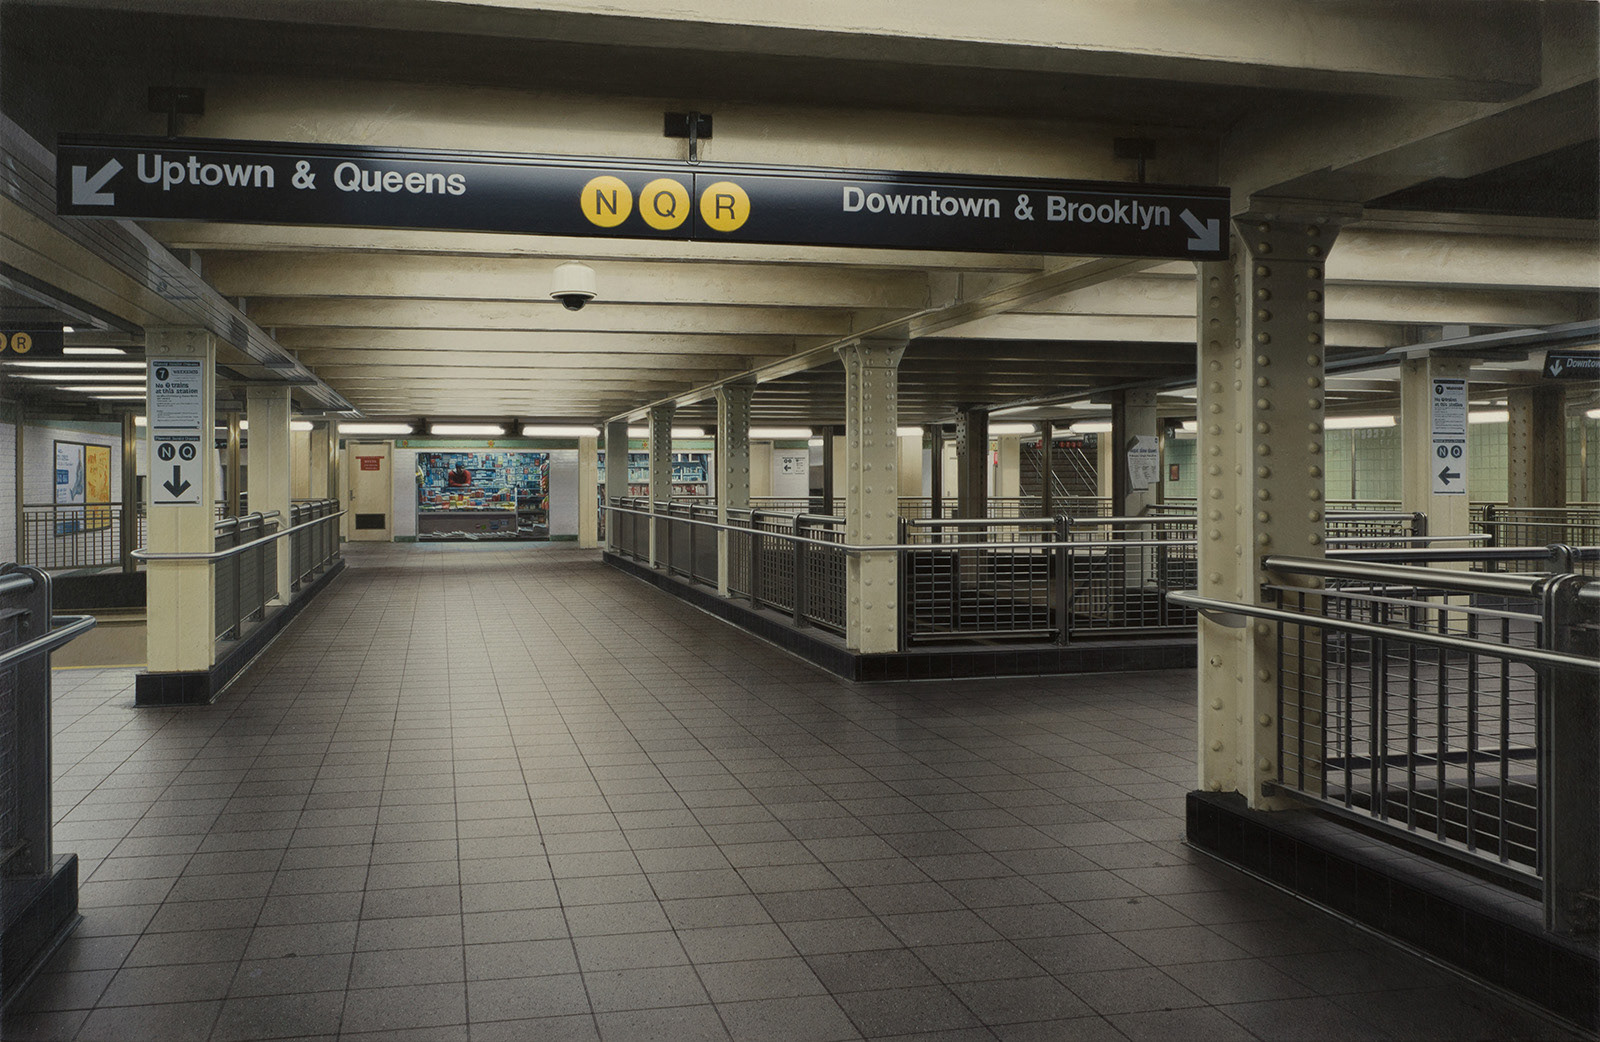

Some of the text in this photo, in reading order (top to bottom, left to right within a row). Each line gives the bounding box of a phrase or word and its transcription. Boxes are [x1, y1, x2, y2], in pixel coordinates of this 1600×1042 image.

[137, 154, 466, 196] Uptown & Queens
[595, 189, 736, 220] N Q R
[843, 186, 1170, 230] Downtown & Brooklyn
[17, 336, 26, 349] R
[162, 446, 193, 459] N Q
